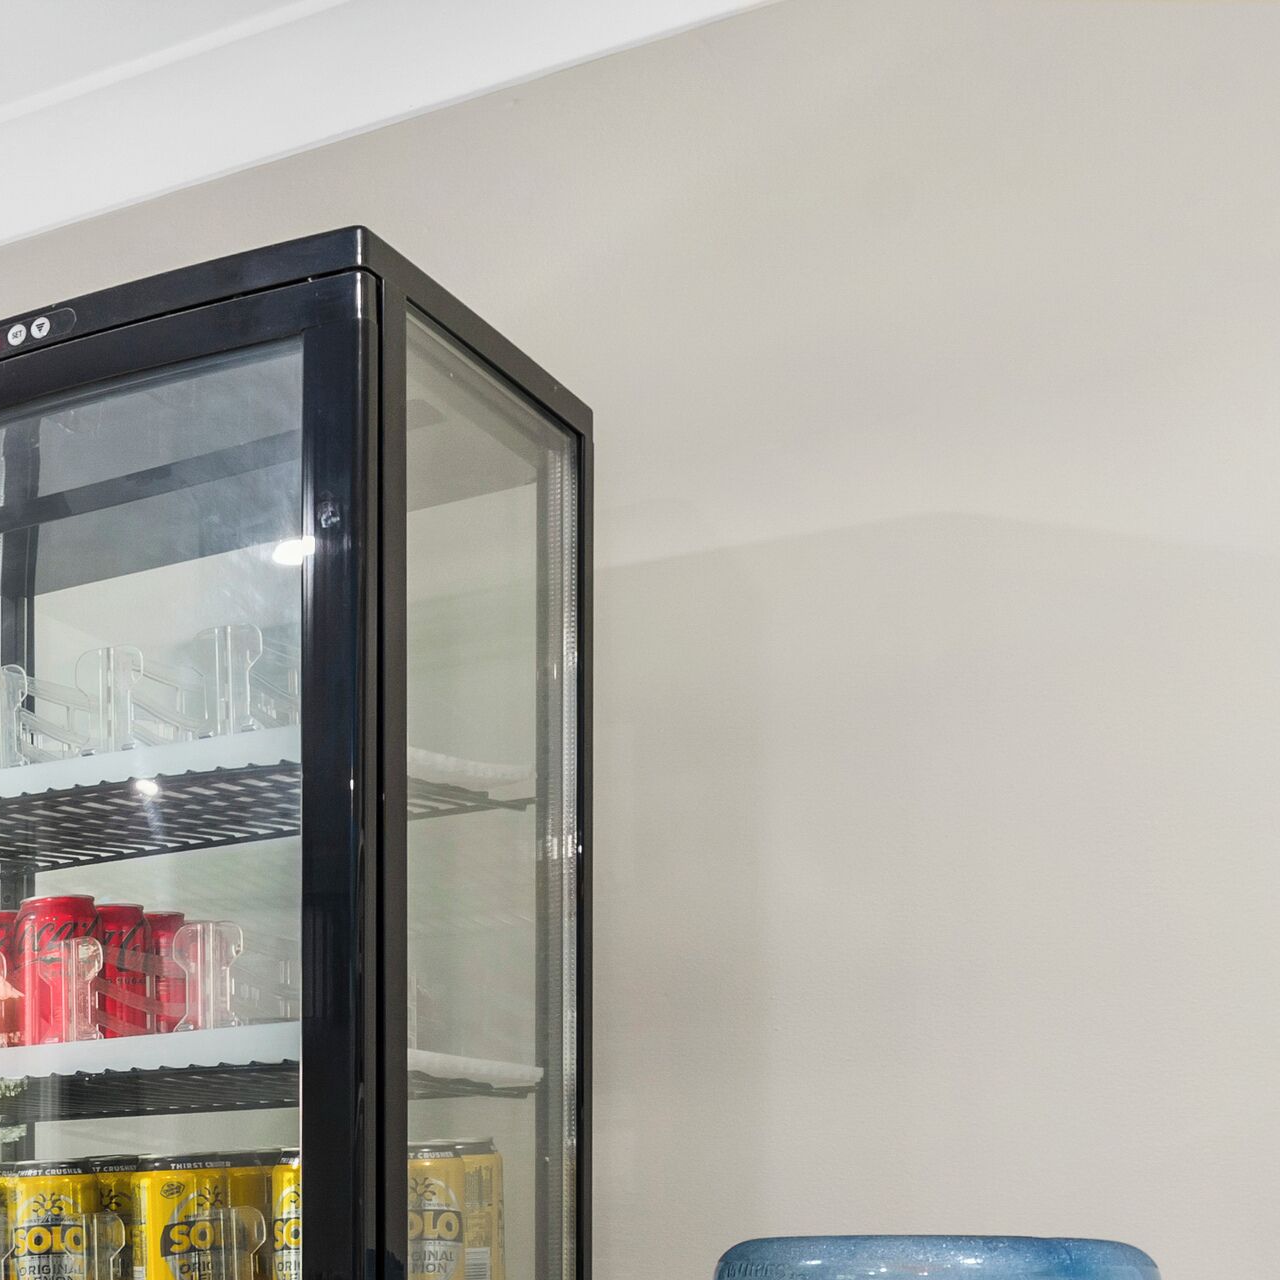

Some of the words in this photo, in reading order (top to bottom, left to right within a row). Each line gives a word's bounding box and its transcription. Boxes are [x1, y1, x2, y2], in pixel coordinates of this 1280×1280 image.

[44, 1167, 83, 1176] CRUSHER
[169, 1161, 203, 1171] THIRST
[274, 1218, 301, 1251] SO
[14, 1226, 84, 1258] SOLO
[19, 1264, 84, 1277] ORIGINAL
